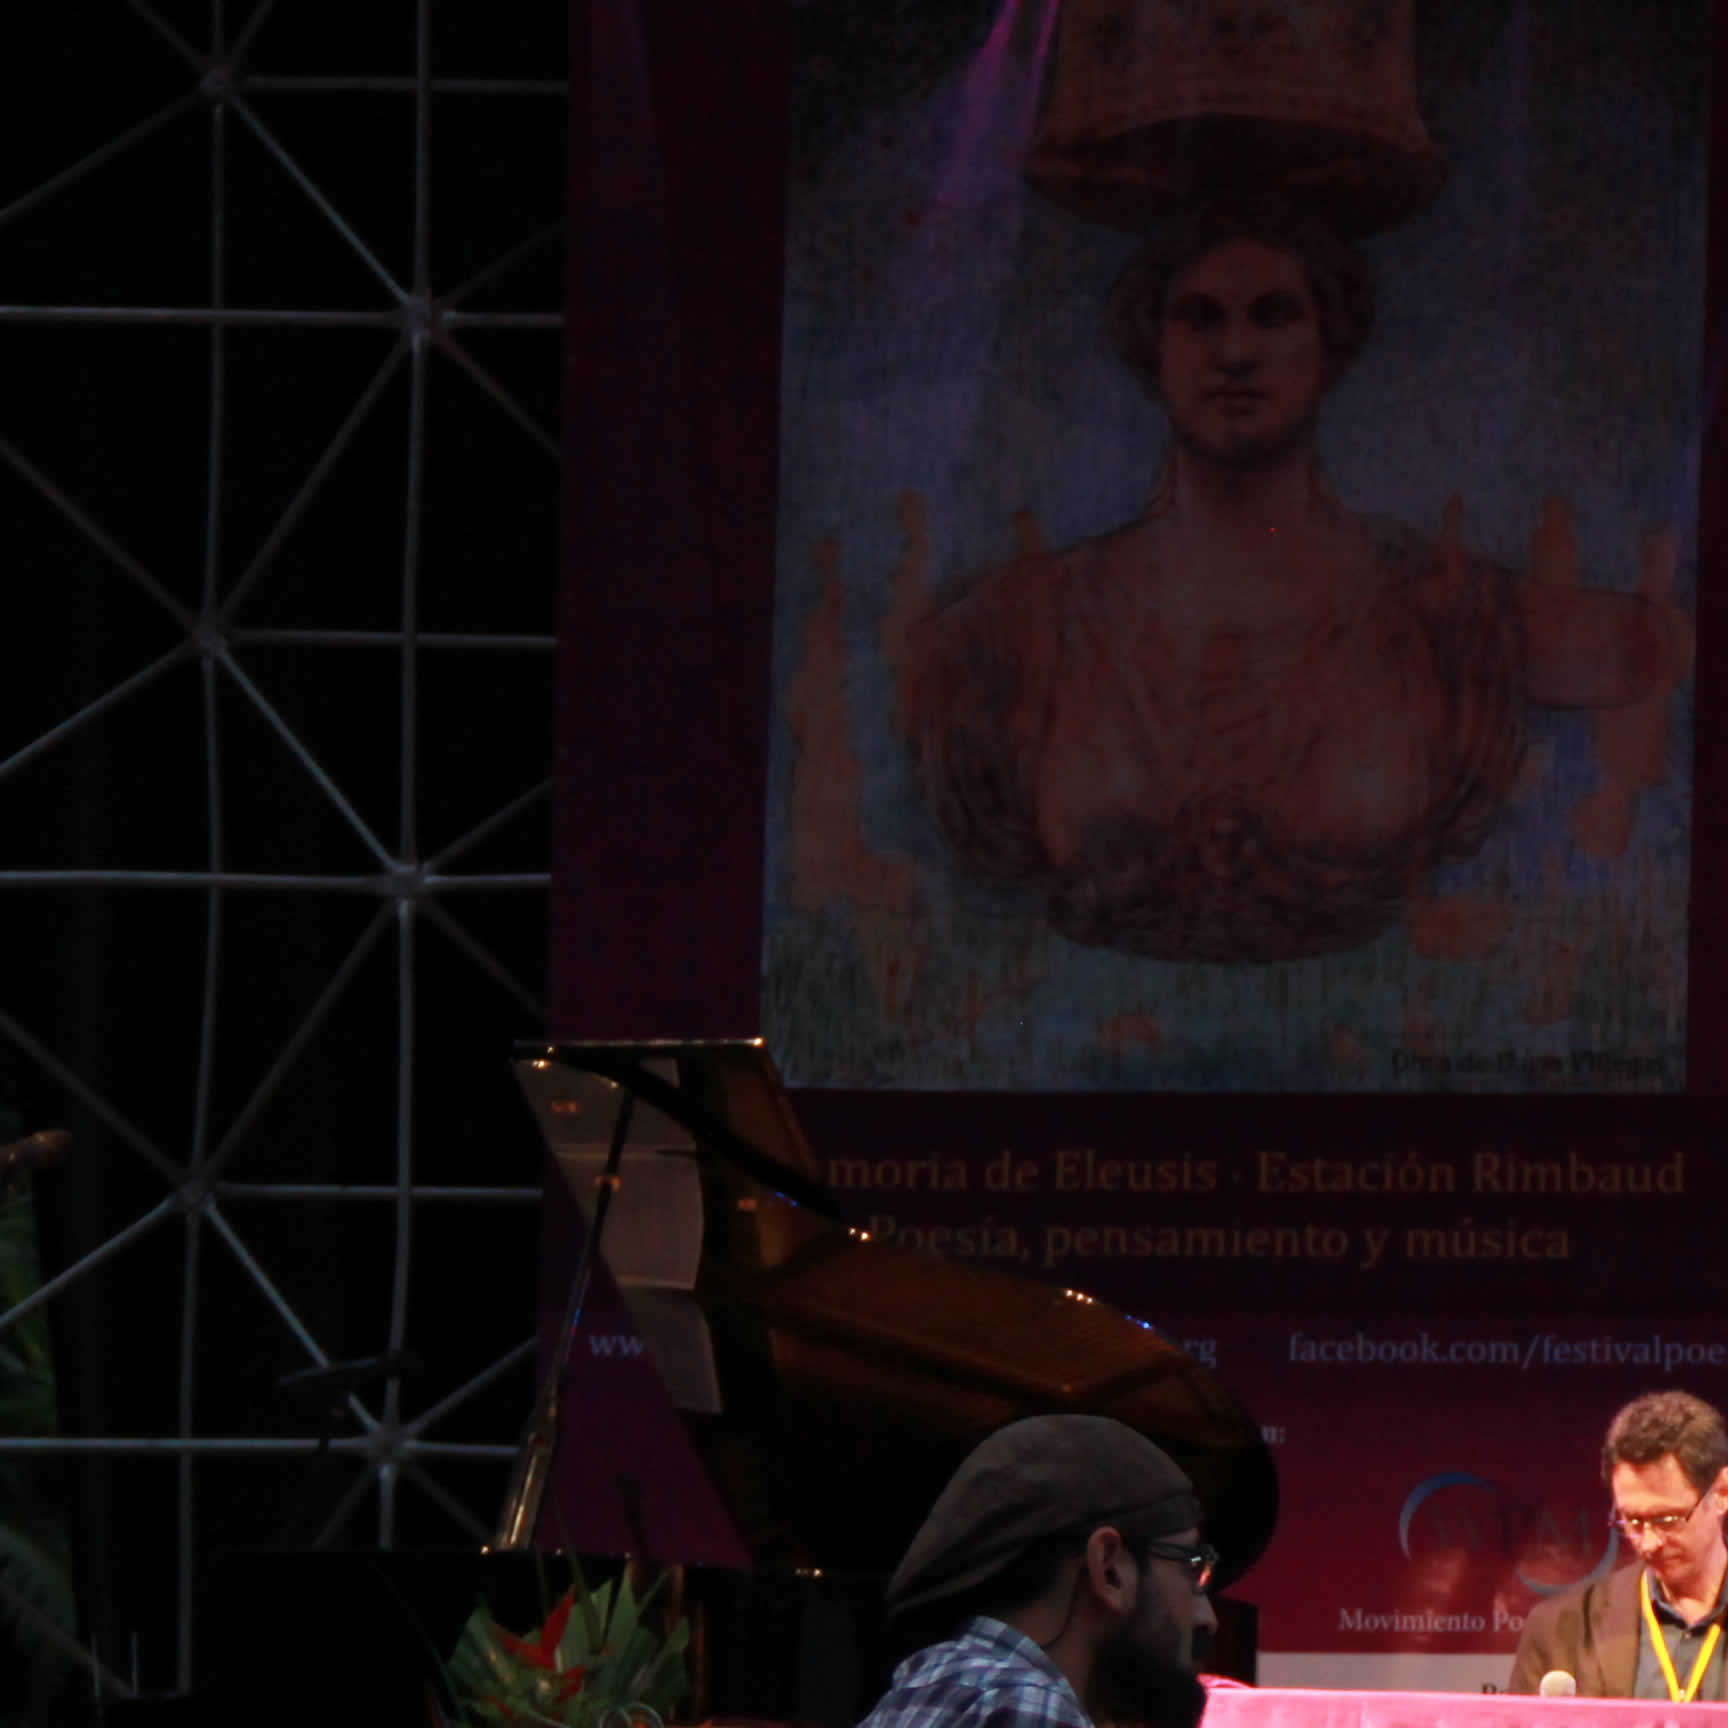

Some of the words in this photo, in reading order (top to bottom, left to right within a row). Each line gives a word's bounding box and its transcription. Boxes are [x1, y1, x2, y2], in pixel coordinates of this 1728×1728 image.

[829, 1151, 968, 1192] moria
[984, 1149, 1039, 1192] de
[1055, 1148, 1217, 1193] Eleusis
[1256, 1150, 1456, 1193] Estación
[1472, 1150, 1687, 1194] Rimbaud
[868, 1214, 1030, 1261] Poesía,
[1044, 1220, 1349, 1270] pensamiento
[1360, 1224, 1388, 1271] y
[1406, 1217, 1570, 1259] música
[1338, 1607, 1485, 1633] Movimiento
